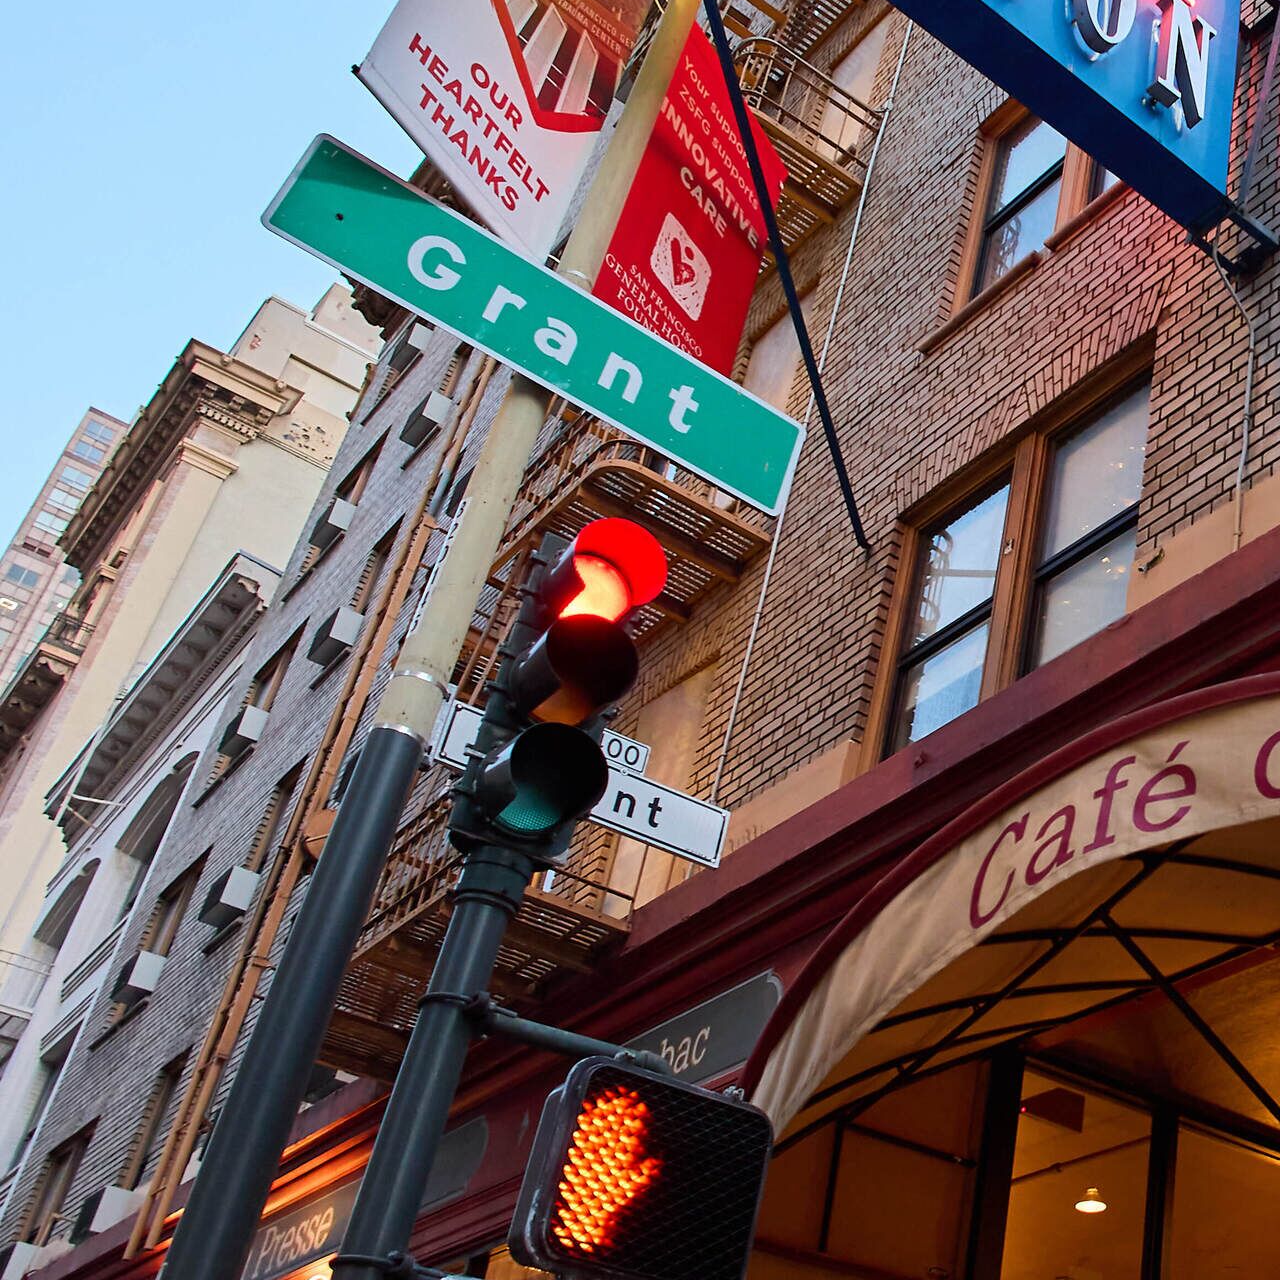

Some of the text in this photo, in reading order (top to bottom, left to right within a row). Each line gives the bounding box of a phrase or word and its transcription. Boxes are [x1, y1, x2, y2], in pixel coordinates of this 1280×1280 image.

[590, 23, 622, 55] CENTER
[408, 32, 550, 203] HEARTFELT
[470, 62, 524, 132] OUR
[684, 55, 752, 169] Your suppor
[419, 83, 520, 212] THANKS
[660, 96, 760, 249] INNOVATIVE
[679, 84, 760, 211] ZSFG supports
[680, 166, 727, 239] CARE
[407, 235, 700, 434] Grant
[605, 253, 660, 325] GENERAL
[630, 264, 703, 358] SAN FRANCISCO
[602, 737, 641, 766] 00
[969, 740, 1197, 930] Café
[660, 1024, 711, 1075] bac
[251, 1207, 335, 1280] Presse
